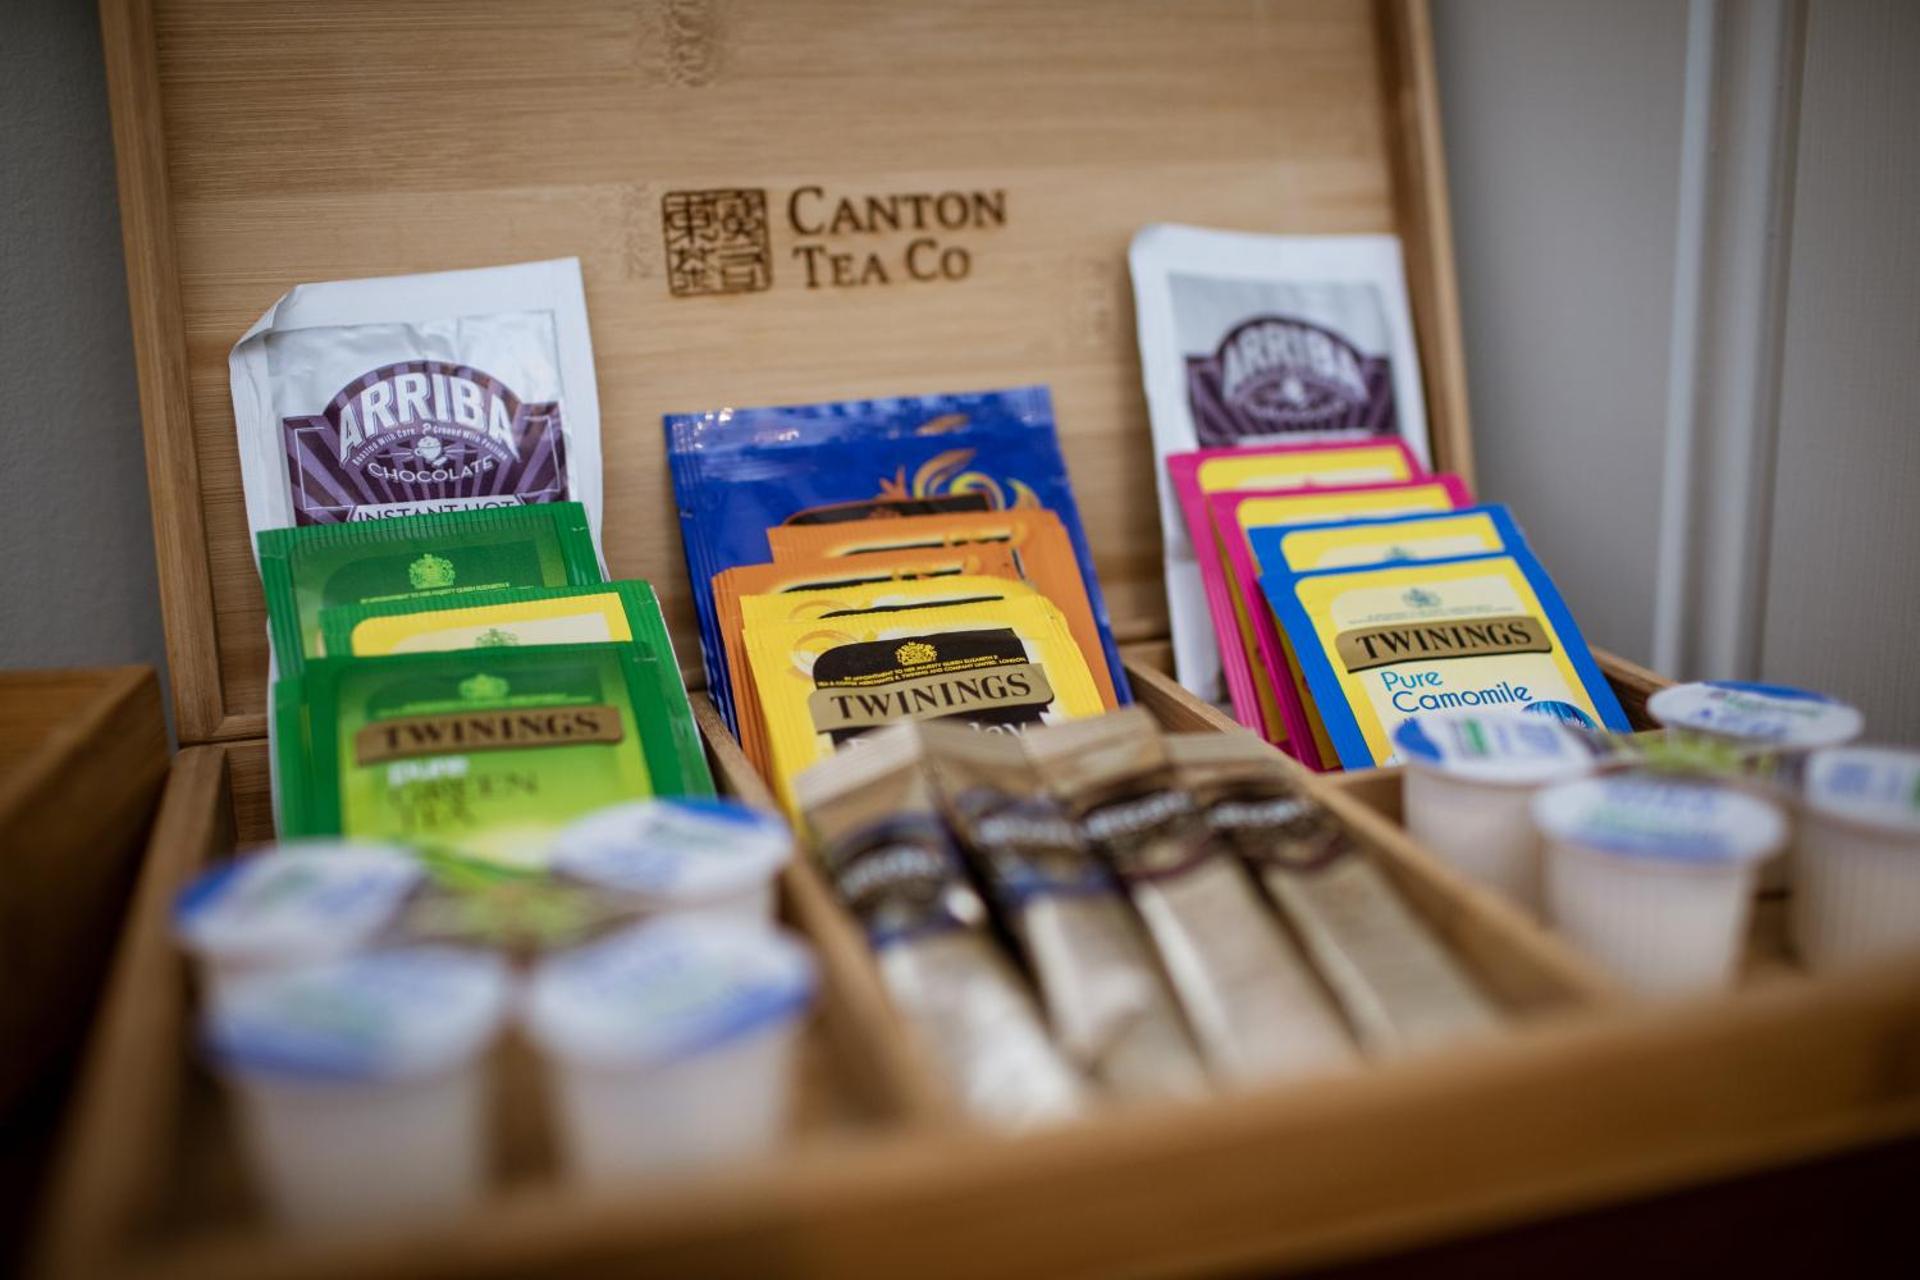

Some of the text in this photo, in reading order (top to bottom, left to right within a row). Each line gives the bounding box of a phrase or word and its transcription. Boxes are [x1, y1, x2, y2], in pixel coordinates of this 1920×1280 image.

[792, 244, 890, 290] TEA
[1222, 322, 1370, 402] ARRIBA
[337, 371, 521, 465] ARRIBA
[367, 454, 494, 483] CHOCOLATE
[1354, 621, 1534, 661] TWININGS
[829, 672, 1031, 718] TWININGS
[1380, 669, 1444, 692] Pure
[1391, 681, 1534, 714] Camomile
[383, 711, 600, 750] TWININGS
